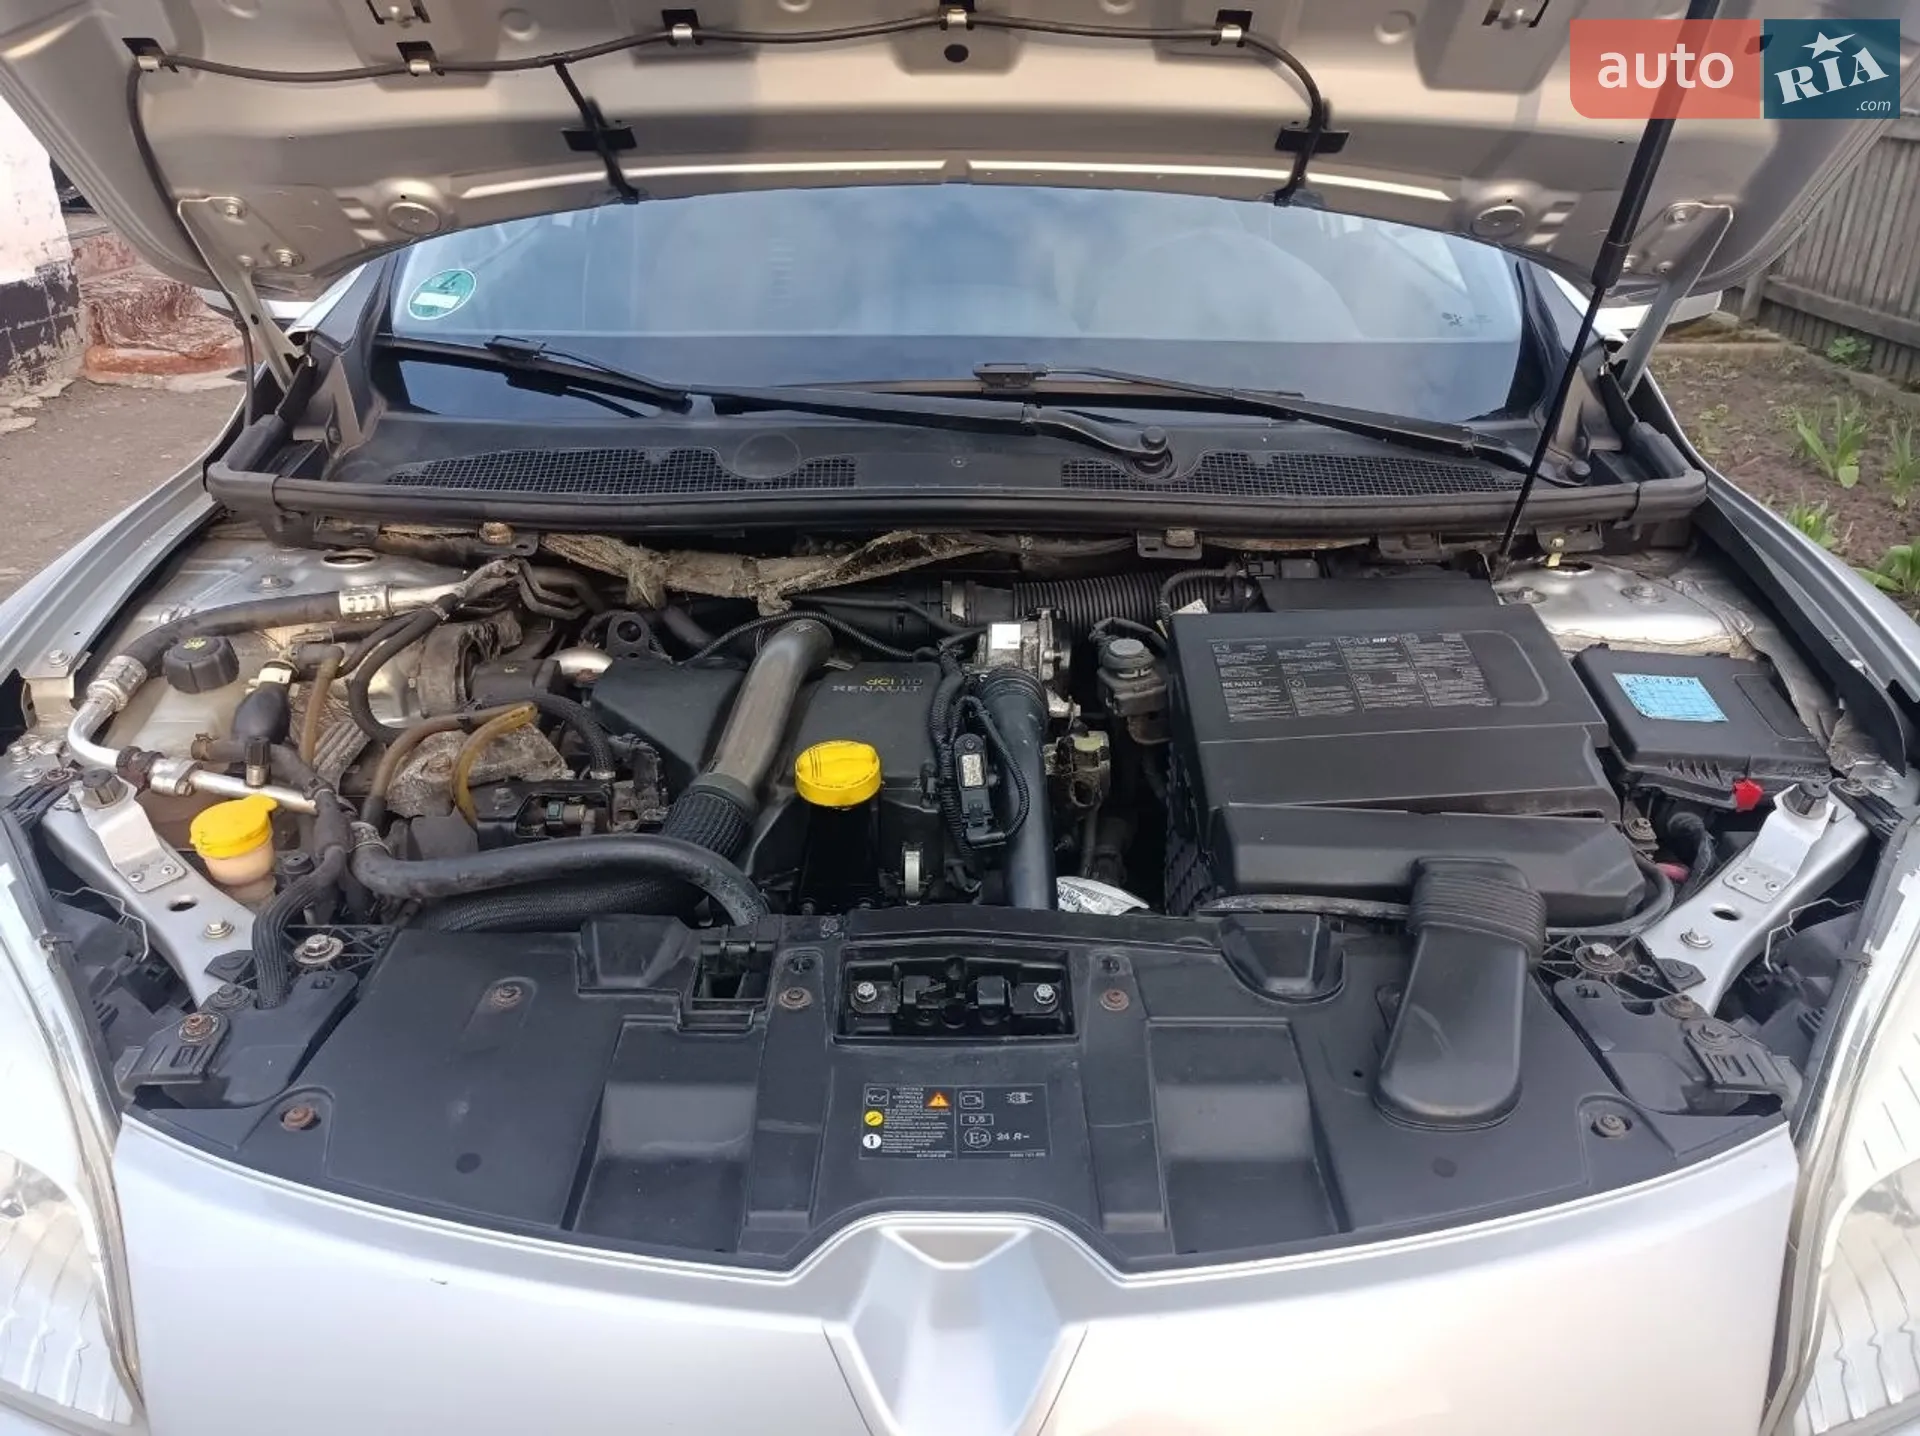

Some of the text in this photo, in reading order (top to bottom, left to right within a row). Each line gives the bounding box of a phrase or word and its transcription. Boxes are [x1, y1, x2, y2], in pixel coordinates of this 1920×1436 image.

[831, 685, 922, 693] RENAULT
[969, 1131, 988, 1145] E2
[996, 1132, 1010, 1141] 24
